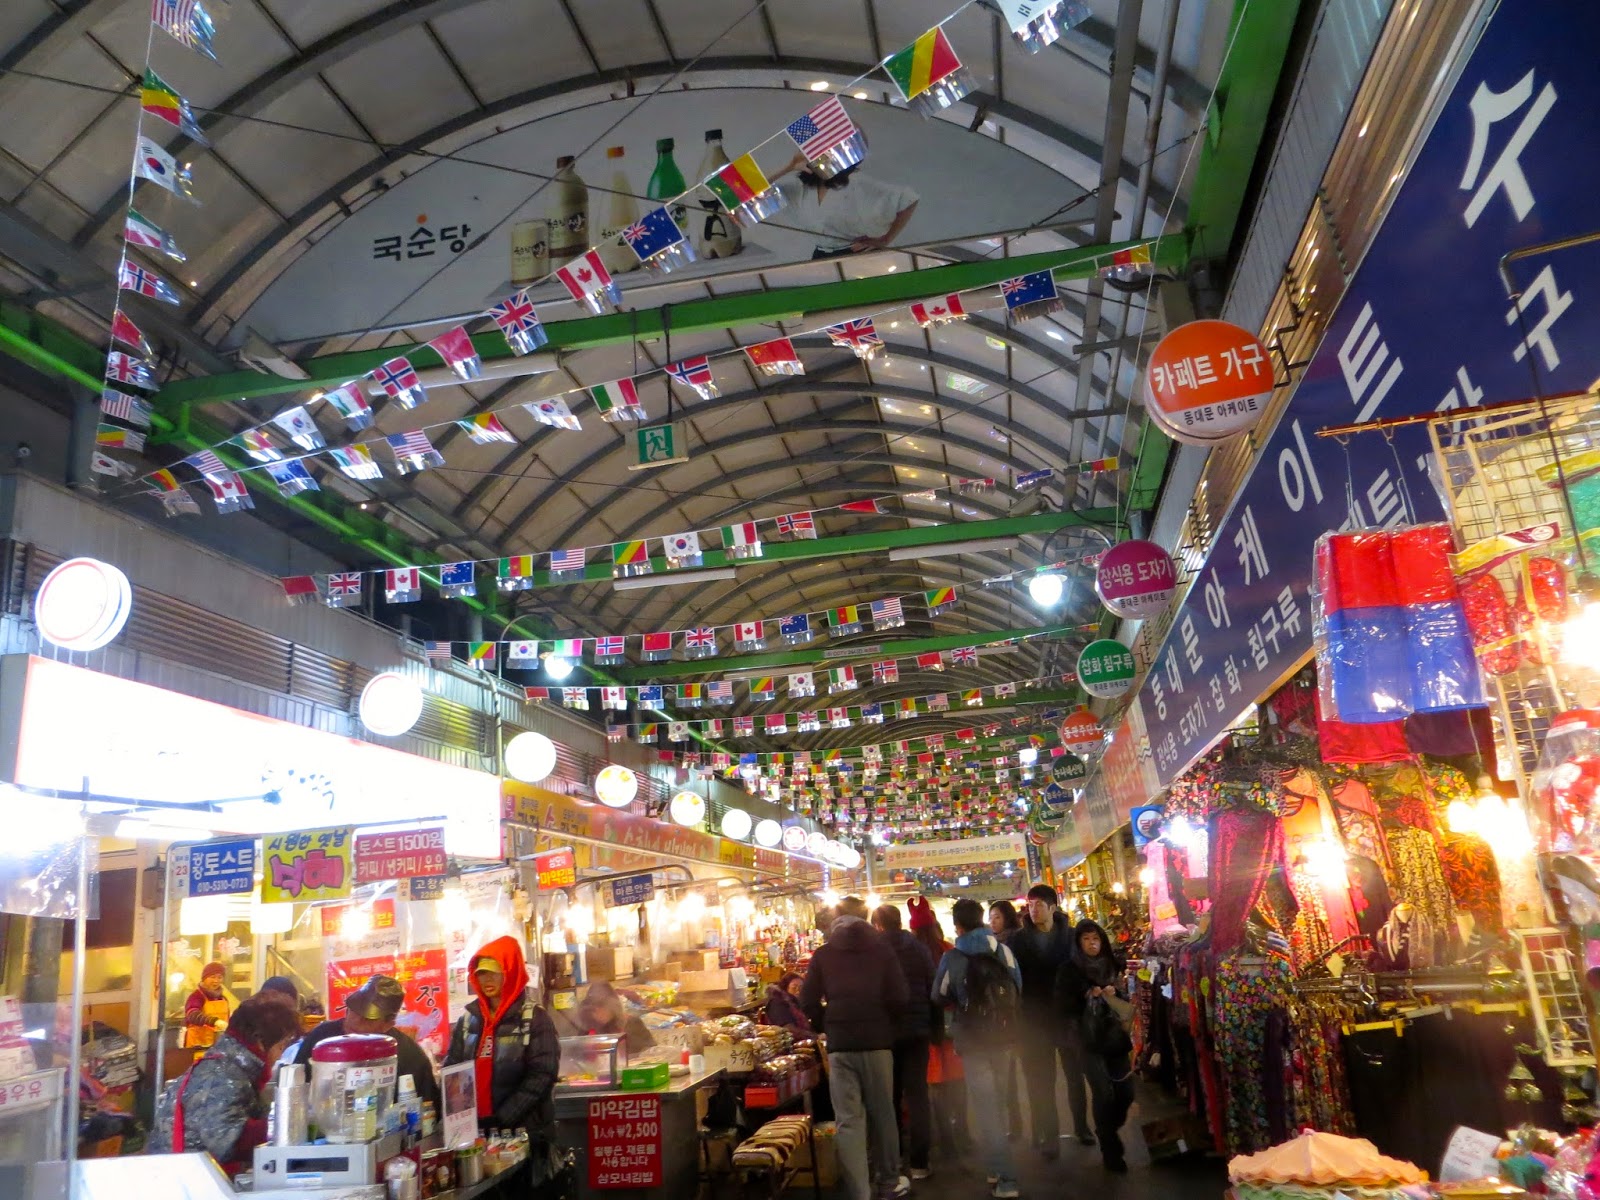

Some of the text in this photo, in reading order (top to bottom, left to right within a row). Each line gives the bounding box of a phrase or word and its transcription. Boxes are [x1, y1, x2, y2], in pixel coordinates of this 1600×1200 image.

[373, 225, 471, 261] 국순당
[1152, 343, 1264, 394] 카페트 가구
[1183, 398, 1258, 426] 동대문 아케이트
[1100, 556, 1172, 589] 장식용 도자기
[1121, 595, 1140, 609] 동대문
[1081, 652, 1134, 676] 잡화 침구류
[1152, 614, 1204, 721] 동대문
[1156, 731, 1178, 771] 장식용
[1179, 696, 1208, 746] 도자기
[1247, 585, 1301, 672] 침구류
[268, 829, 349, 852] 시원한 옛날
[360, 832, 444, 857] 토스트 1500원
[204, 848, 253, 876] 토스트
[539, 868, 575, 886] 마약김밥
[590, 1099, 658, 1120] 마약김밥
